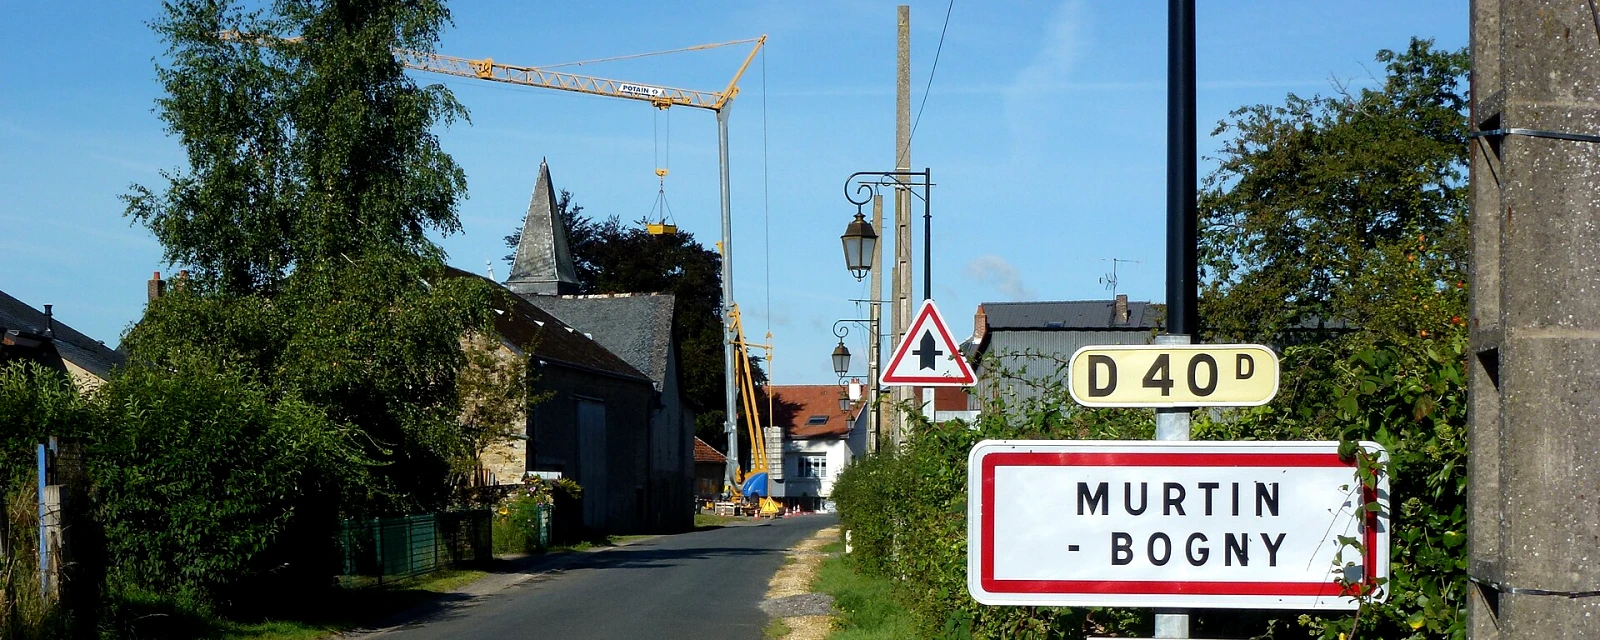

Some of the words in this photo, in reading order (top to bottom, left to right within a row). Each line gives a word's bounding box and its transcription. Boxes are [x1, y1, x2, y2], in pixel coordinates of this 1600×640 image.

[622, 84, 649, 94] POTAIN
[1088, 354, 1118, 397] D
[1077, 482, 1279, 516] MURTIN
[1111, 531, 1286, 567] BOGNY
